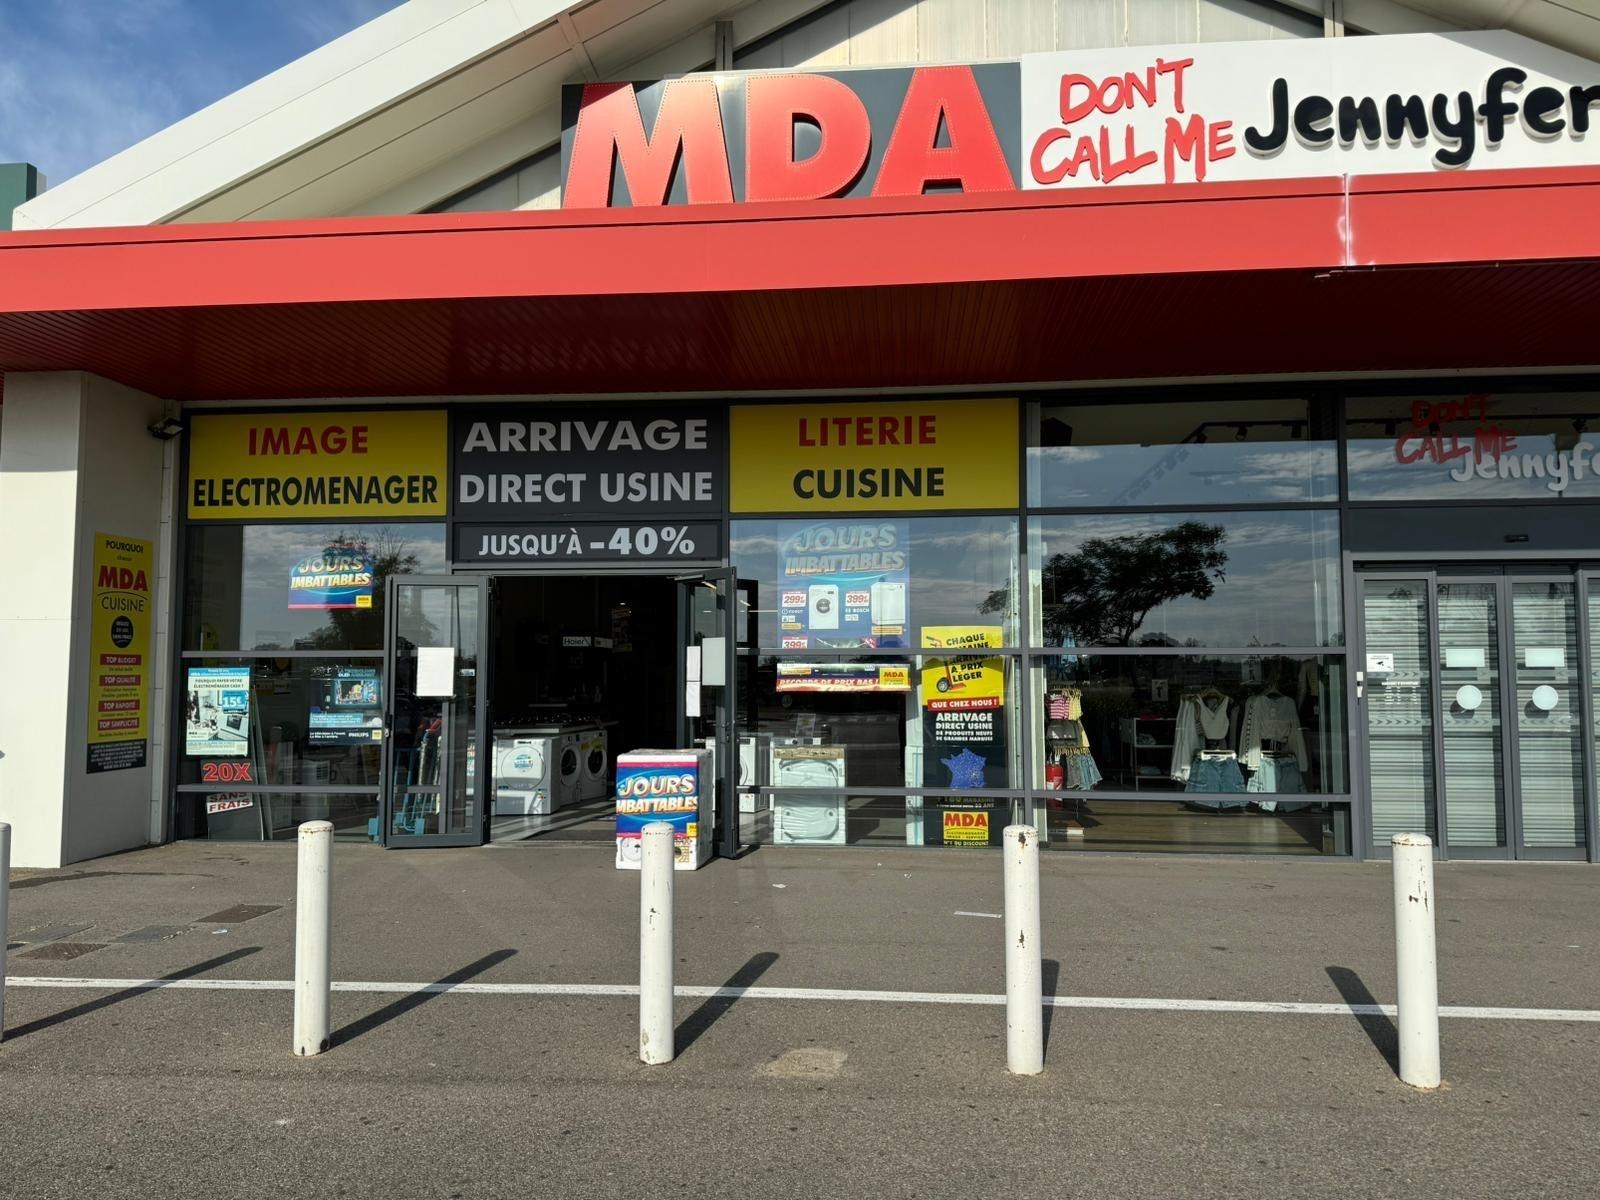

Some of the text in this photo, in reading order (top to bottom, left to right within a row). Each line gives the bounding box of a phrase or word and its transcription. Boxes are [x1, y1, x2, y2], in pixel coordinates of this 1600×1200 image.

[1060, 58, 1194, 123] DON'T
[1244, 67, 1600, 167] Jennyfer
[562, 66, 1018, 209] MDA
[1030, 114, 1236, 184] CALL ME
[248, 426, 369, 456] IMAGE
[462, 419, 708, 452] ARRIVAGE
[799, 415, 936, 447] LITERIE
[1395, 426, 1518, 465] CALL ME
[193, 475, 438, 507] ELECTROMENAGER
[459, 472, 712, 503] DIRECT USINE
[793, 467, 945, 499] CUISINE
[106, 540, 144, 553] POURQUOI
[479, 526, 695, 556] JUSQU'À -40%
[795, 523, 897, 553] JOURS
[298, 556, 364, 573] JOURS
[785, 551, 907, 576] IMBATTABLES
[98, 565, 148, 592] MDA
[291, 573, 372, 589] IMBATTABLES
[101, 596, 144, 612] CUISINE
[564, 637, 584, 645] Haier
[946, 633, 985, 646] CHAQUE
[953, 671, 982, 682] LÉGER
[961, 662, 983, 671] PRIX
[935, 712, 993, 721] ARRIVAGE
[203, 762, 252, 782] 20X
[618, 774, 696, 797] JOURS
[210, 799, 250, 811] FRAIS
[616, 796, 698, 814] MBATTABLES
[944, 813, 988, 826] MDA
